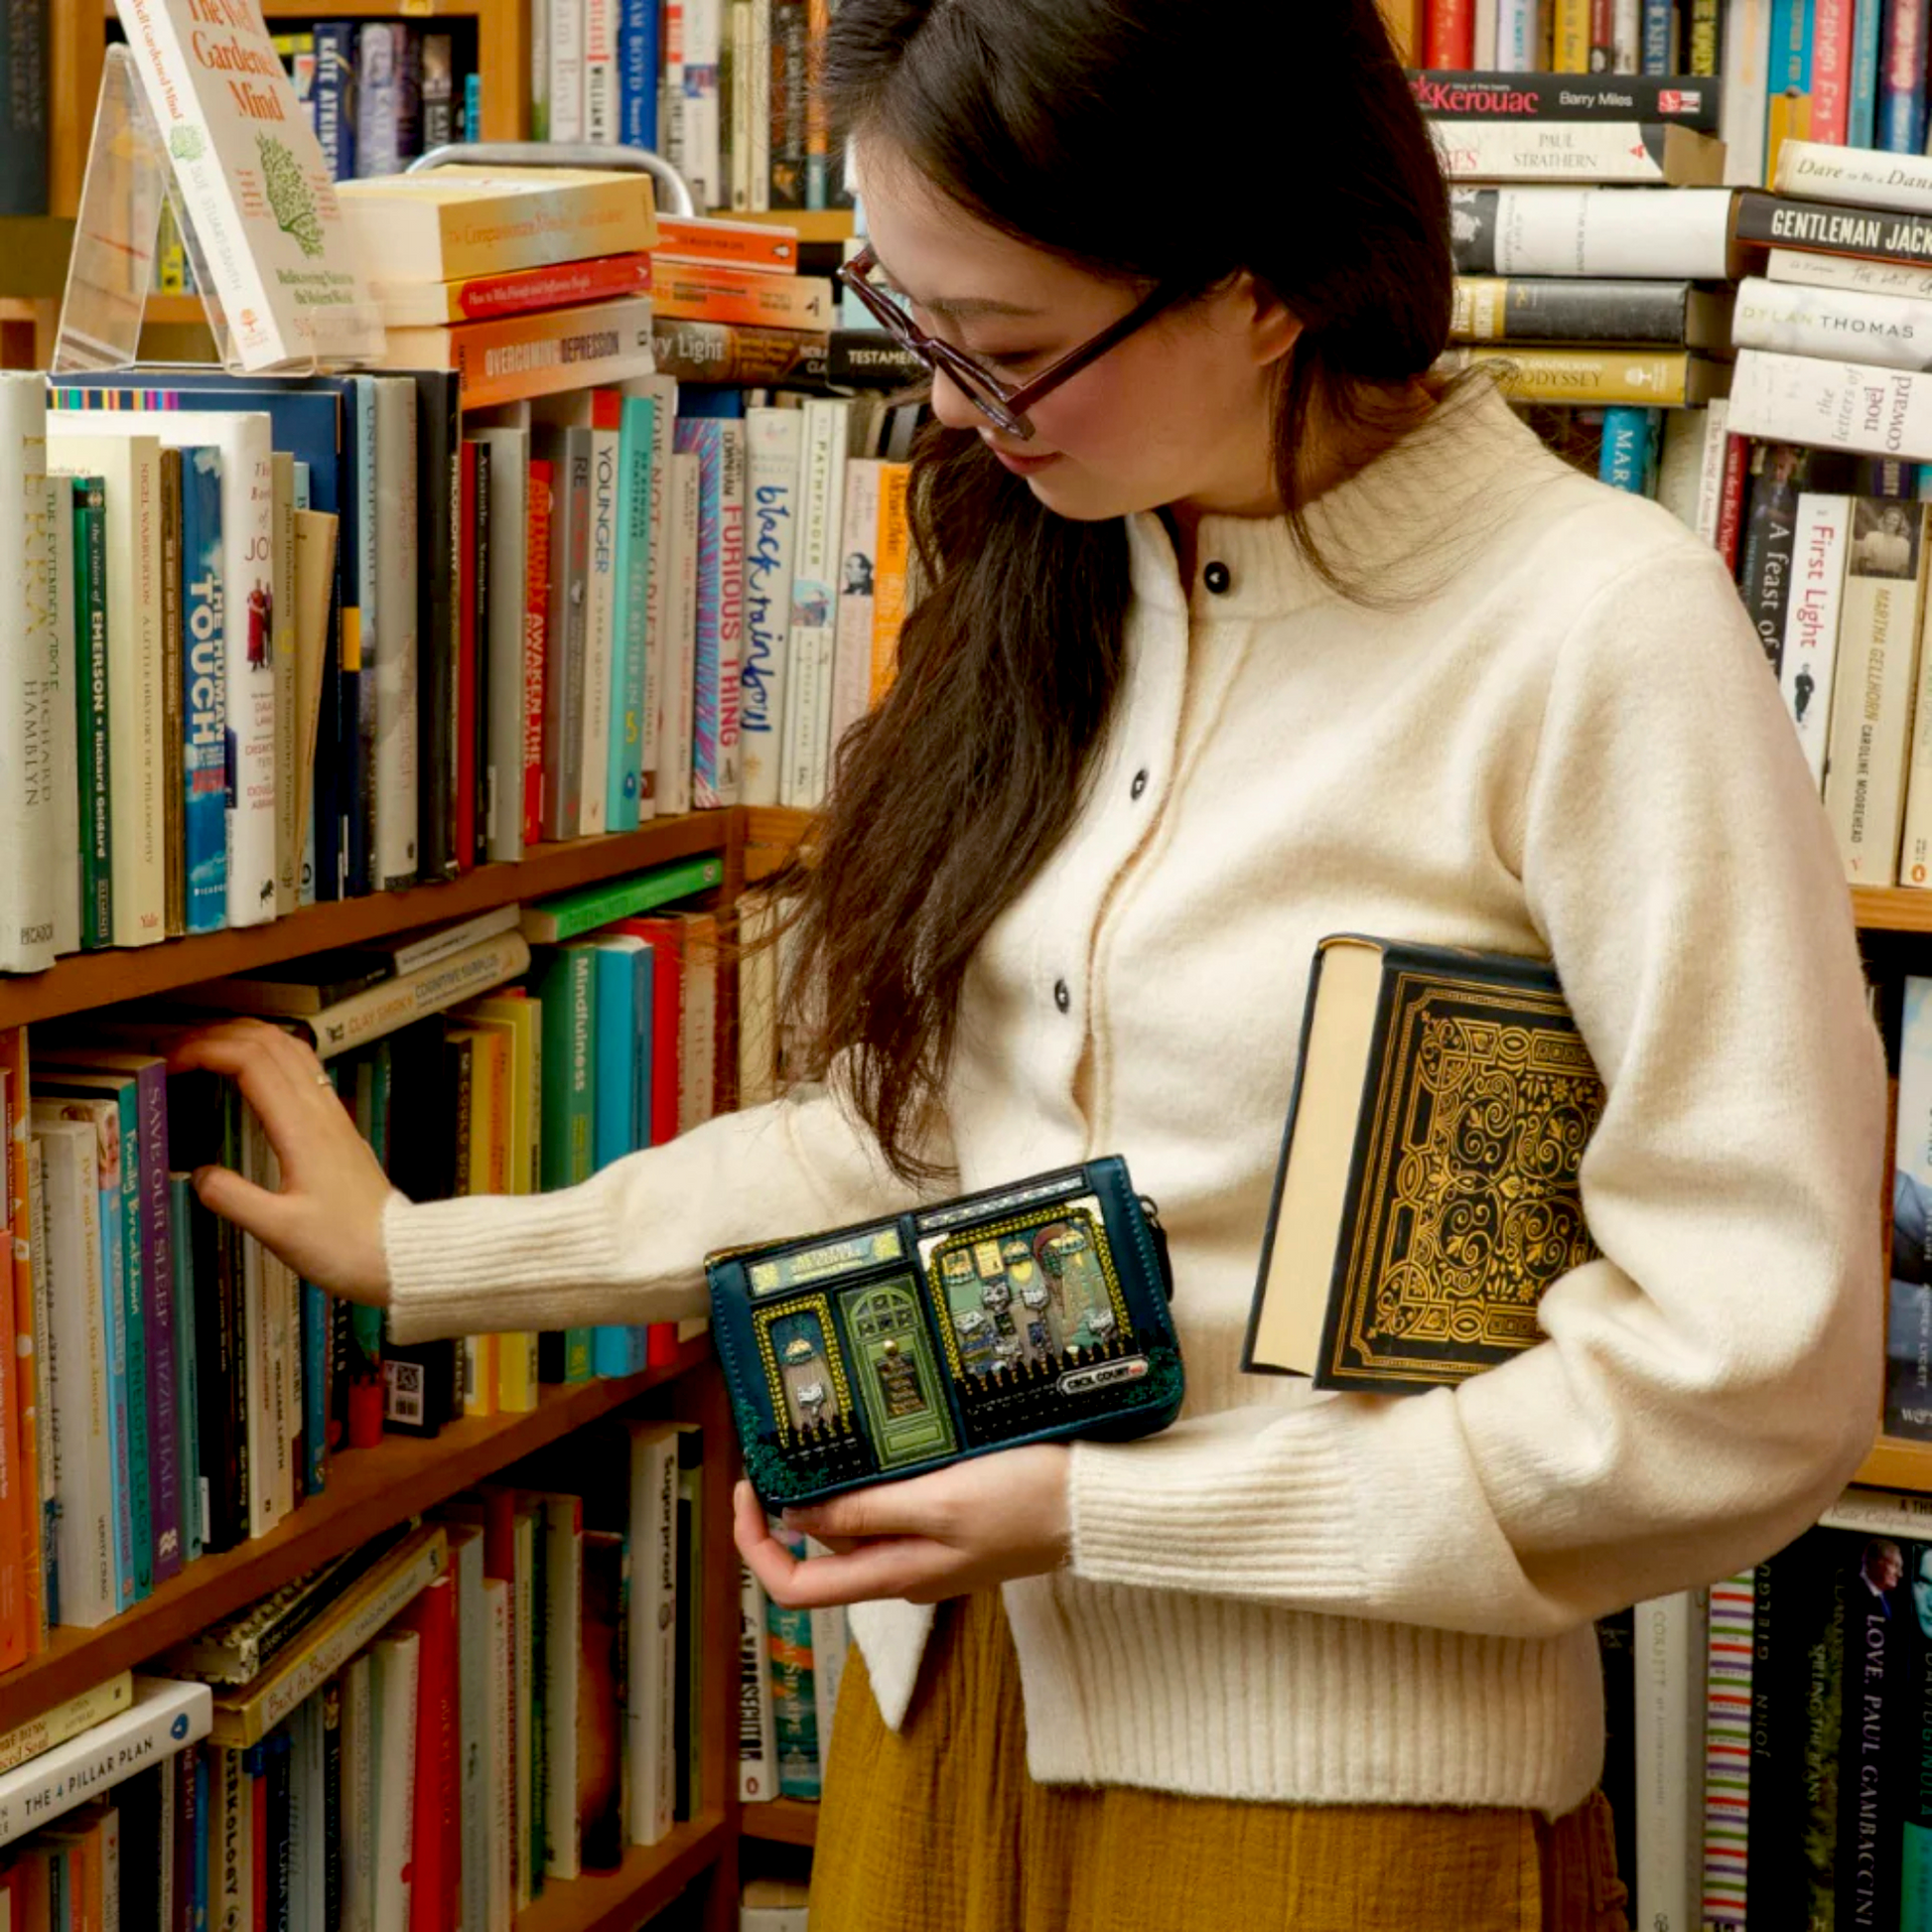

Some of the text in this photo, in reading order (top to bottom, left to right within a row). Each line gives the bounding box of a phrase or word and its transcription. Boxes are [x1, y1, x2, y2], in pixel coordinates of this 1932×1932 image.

[319, 38, 339, 83] KATE
[227, 79, 285, 122] Mind
[1559, 90, 1634, 108] Barry Miles
[1514, 154, 1597, 168] STRATHERN
[1538, 133, 1576, 148] PAUL
[1797, 159, 1844, 179] Dare
[1771, 209, 1881, 247] GENTLEMAN
[484, 330, 620, 378] OVERCOMING DEPRESSION
[678, 332, 724, 364] Light
[1742, 307, 1914, 340] DYLAN THOMAS
[848, 349, 918, 365] TESTAMEN
[1816, 387, 1835, 417] the
[1832, 388, 1857, 443] letters
[1863, 385, 1885, 433] noël
[1885, 375, 1913, 453] coward
[141, 462, 150, 504] NIGEL
[723, 432, 736, 496] DOWNHAM
[595, 447, 614, 574] YOUNGER
[809, 441, 829, 567] PATHFINDER
[141, 511, 151, 607] WARBURTON
[1756, 521, 1791, 650] A feast of
[1796, 524, 1835, 649] First Light
[142, 616, 151, 627] A
[719, 504, 744, 748] FURIOUS THING
[740, 485, 791, 733] black rainbow
[142, 631, 152, 681] LITTLE
[190, 574, 214, 745] TOUCH
[92, 522, 108, 860] the vision of EMERSON Richard Geldard
[143, 683, 152, 747] HISTORY
[1850, 587, 1891, 845] MARTHA GELLHORN CAROLINE MOOREHEAD
[24, 680, 39, 808] HAMBLYN
[143, 770, 153, 867] PHILOSOPHY
[575, 956, 589, 1092] Mindfulness
[149, 1086, 165, 1163] SAVE
[82, 1194, 92, 1227] and
[153, 1168, 167, 1231] OUR
[154, 1239, 169, 1327] SLEEP
[121, 1128, 150, 1549] Family Breakdown PENELOPE LEACH
[159, 1434, 174, 1510] HALL
[25, 1789, 52, 1817] THE
[69, 1757, 115, 1793] PILLAR
[118, 1735, 154, 1767] PLAN
[1855, 1694, 1883, 1926] PAUL GAMBACCINI
